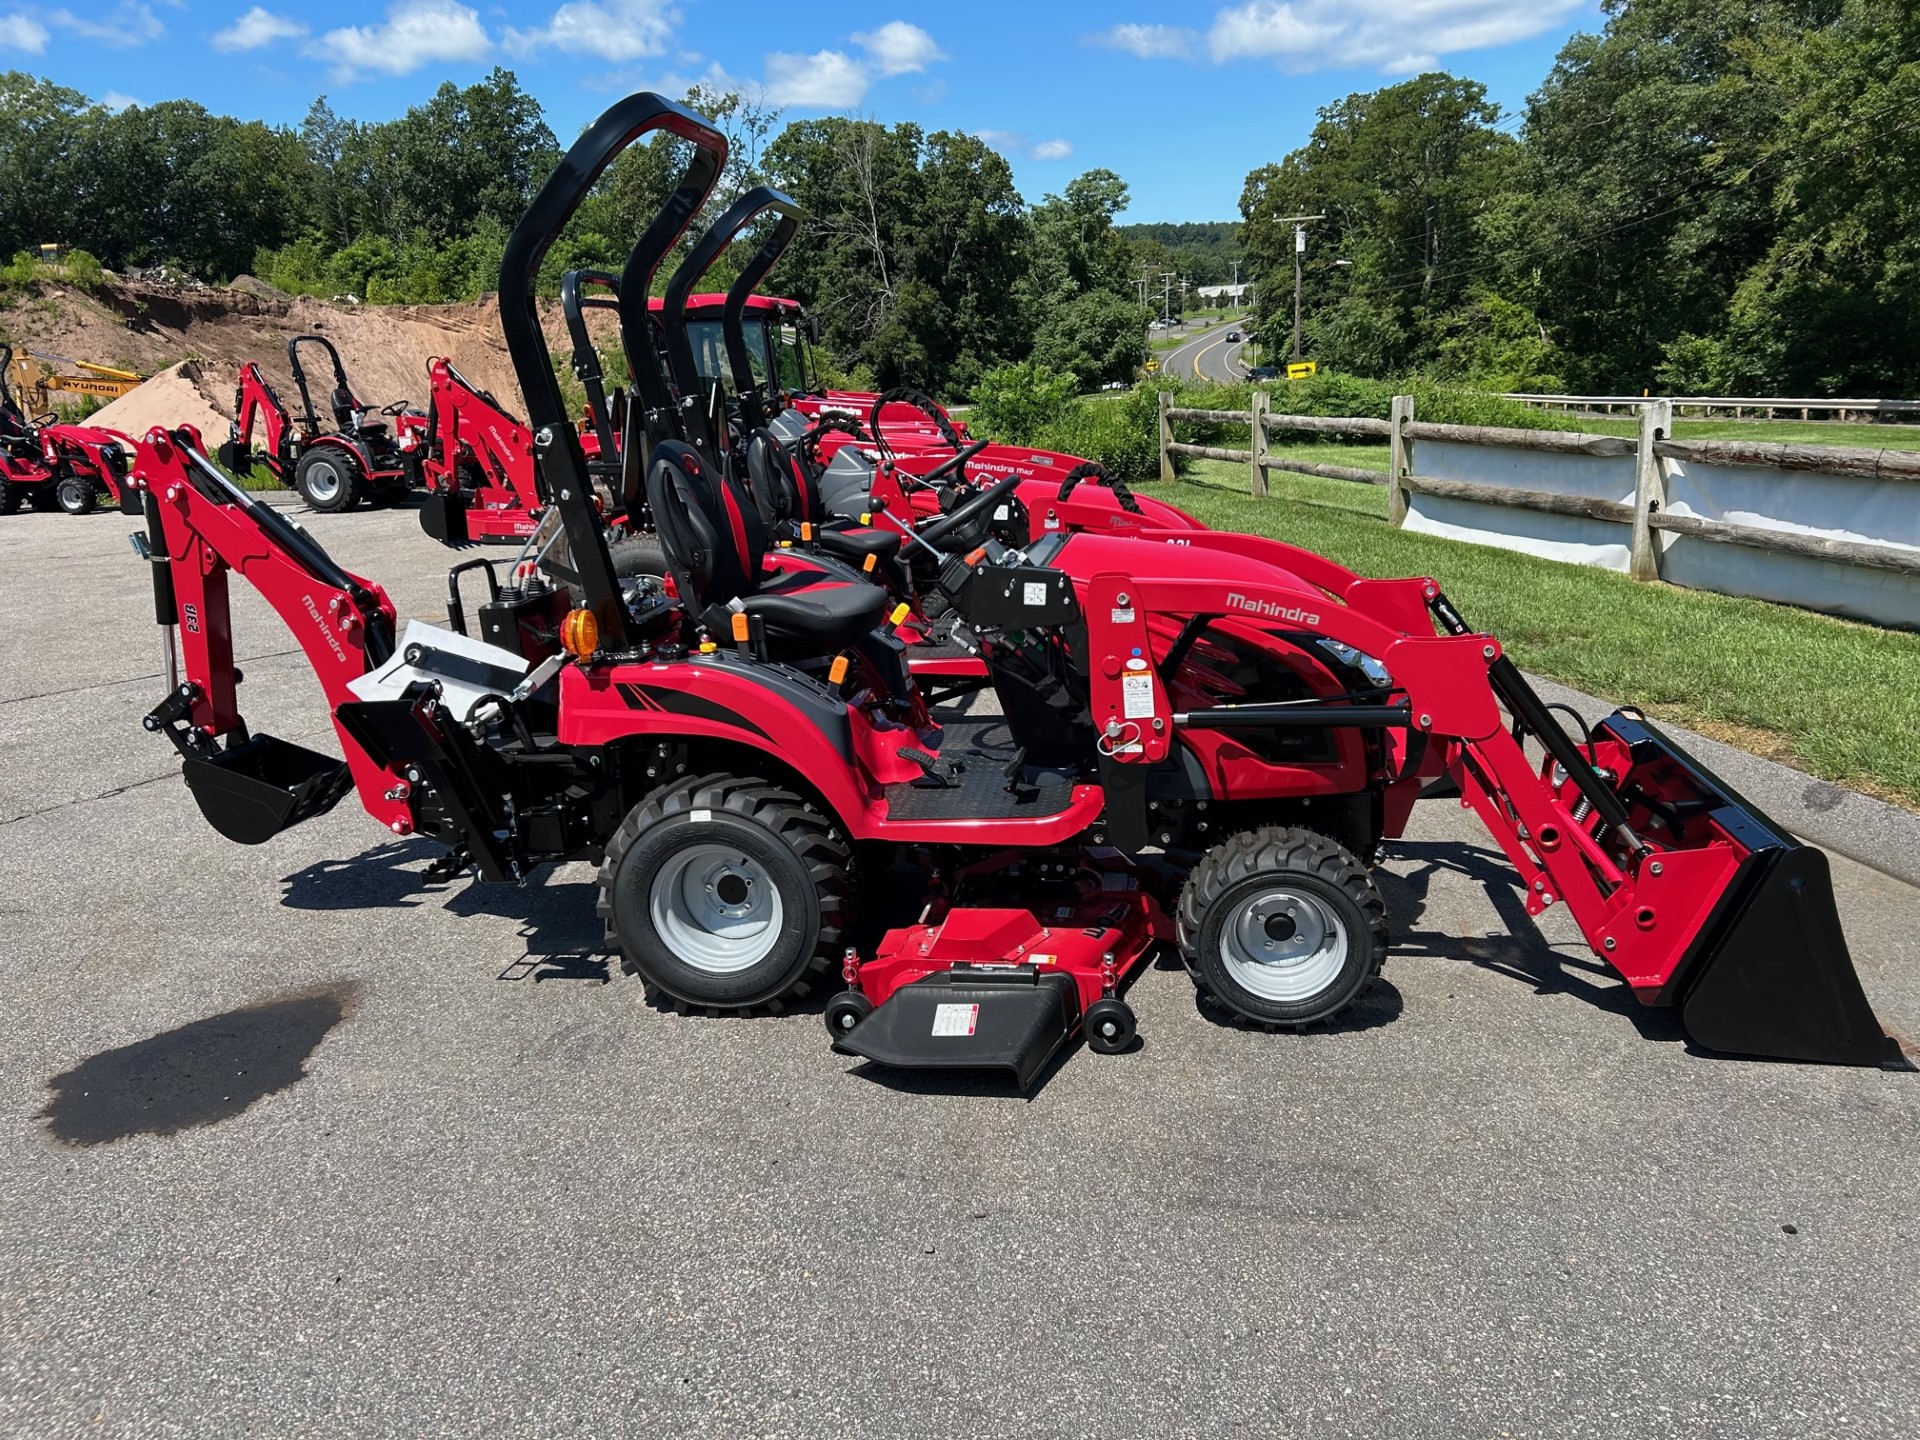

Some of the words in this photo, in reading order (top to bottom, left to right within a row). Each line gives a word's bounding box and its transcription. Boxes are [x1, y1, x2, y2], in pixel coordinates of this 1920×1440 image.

[63, 381, 118, 393] HYUNDAI
[488, 425, 515, 463] Mahindra
[964, 461, 1015, 474] Mahindra
[1016, 467, 1035, 476] Max
[184, 603, 201, 633] 23B
[1225, 592, 1321, 626] Mahindra
[302, 594, 347, 663] Mahindra
